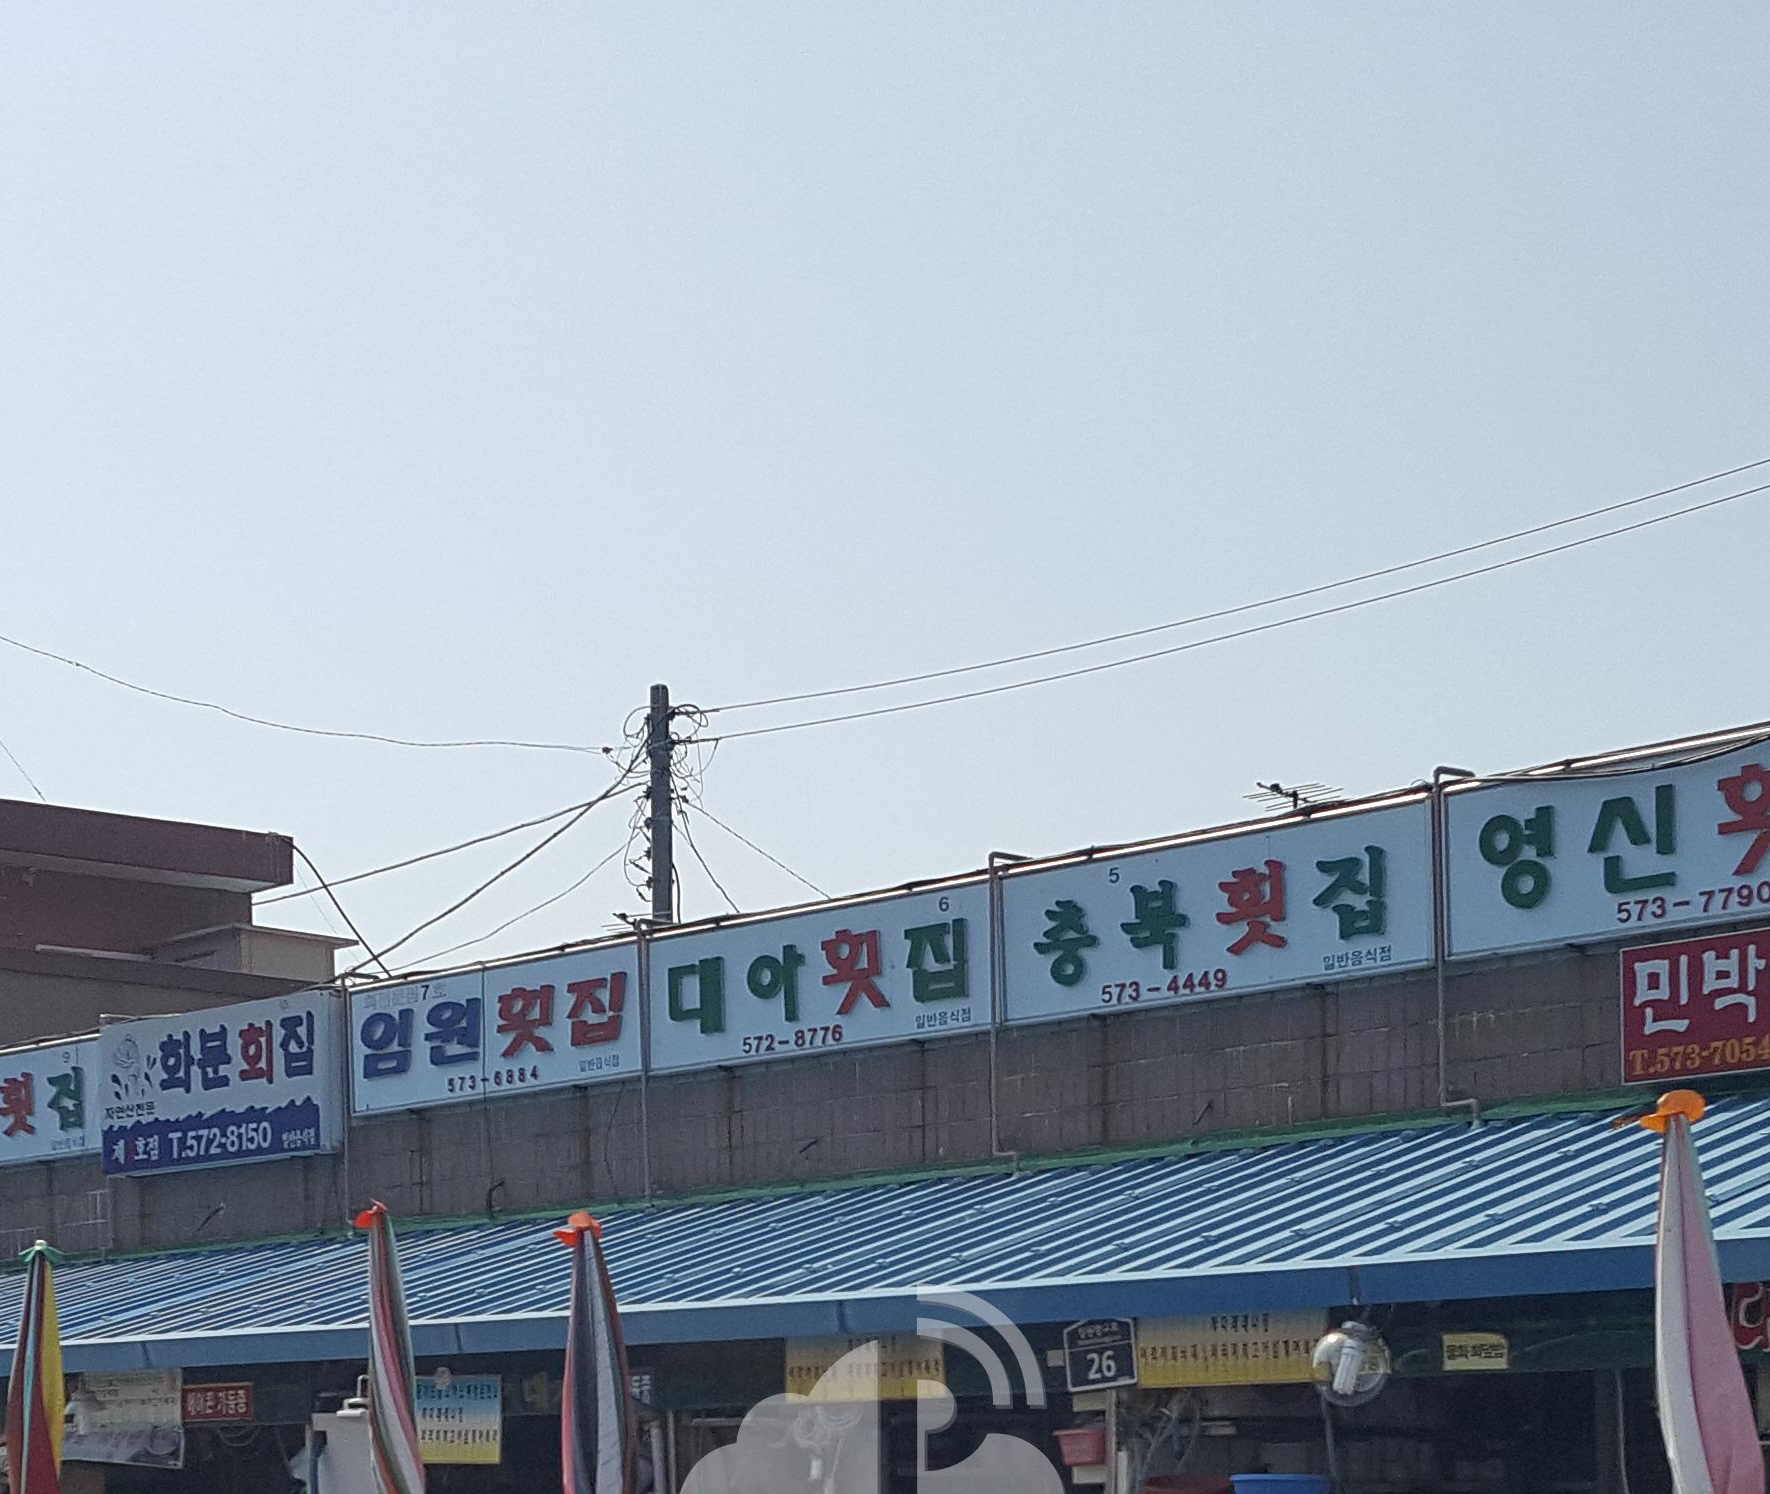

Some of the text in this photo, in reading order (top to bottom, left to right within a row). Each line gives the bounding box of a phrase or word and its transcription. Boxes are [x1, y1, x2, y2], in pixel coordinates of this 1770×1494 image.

[1109, 867, 1120, 884] 5
[938, 895, 951, 912] 6
[1322, 945, 1392, 972] 일반음식점
[1100, 968, 1228, 1004] 573-4449
[1633, 943, 1768, 1036] 민박
[360, 971, 628, 1080] 임원횟집
[915, 1007, 972, 1029] 일반음식점
[742, 1024, 844, 1055] 572-8776
[167, 1121, 272, 1160] T.572-8150
[1085, 1349, 1118, 1381] 26
